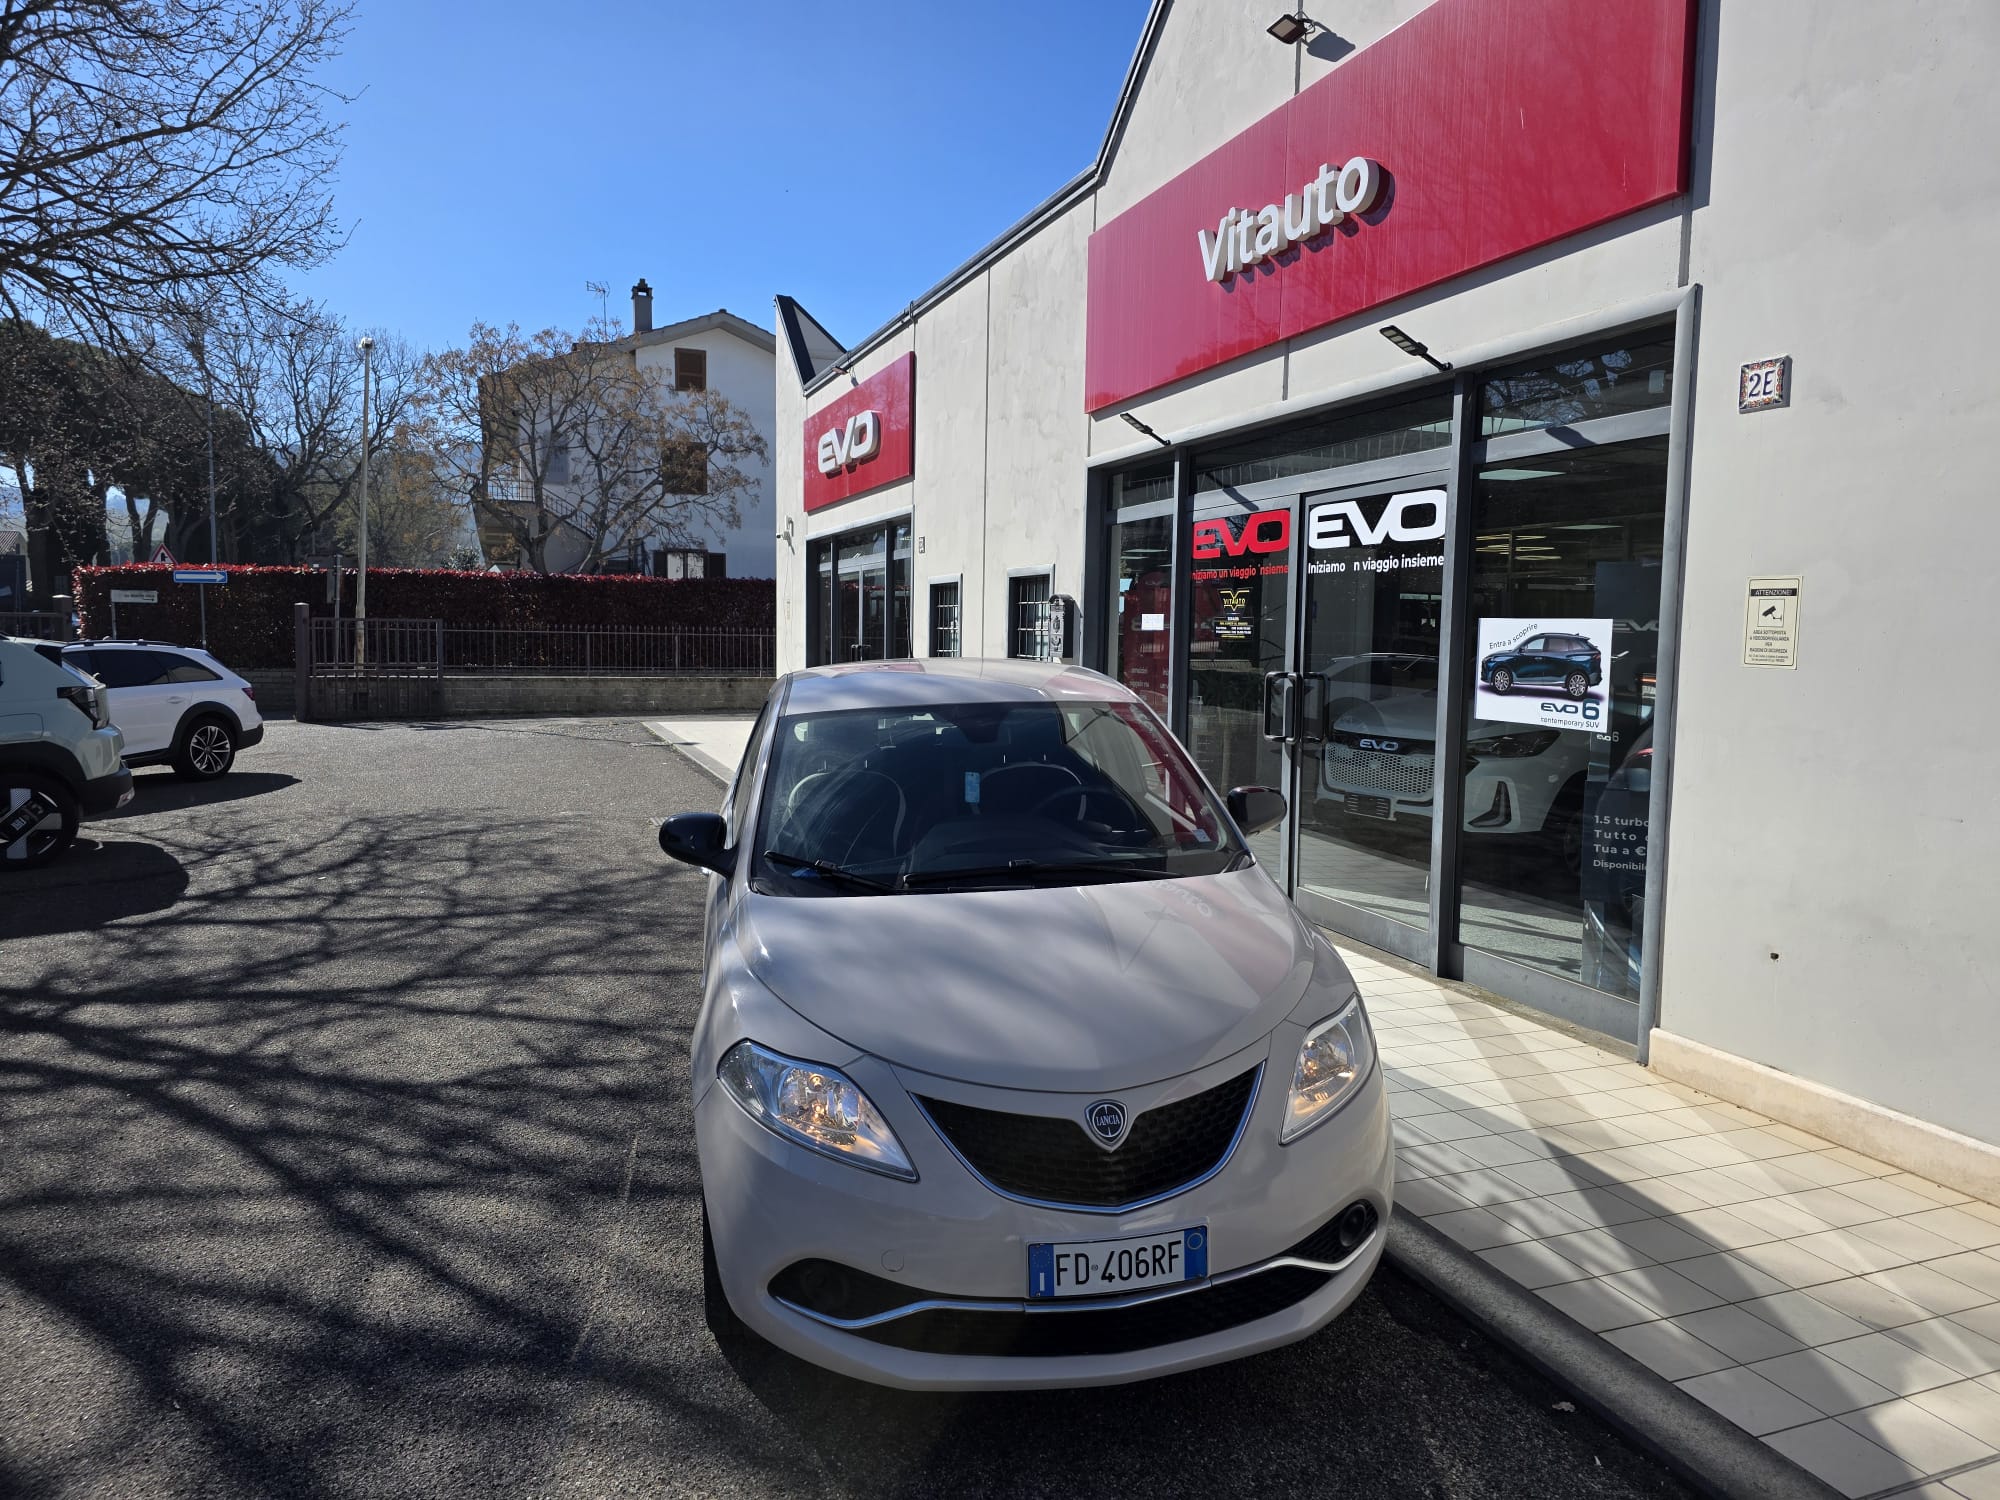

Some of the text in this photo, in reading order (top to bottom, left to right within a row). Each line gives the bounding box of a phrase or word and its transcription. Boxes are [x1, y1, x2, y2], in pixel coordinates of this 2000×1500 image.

[1198, 157, 1374, 281] Vitauto
[818, 410, 877, 473] EVO
[1308, 489, 1447, 549] EVO
[1193, 510, 1290, 559] EVO
[1308, 560, 1346, 574] Iniziamo
[1362, 557, 1399, 573] viaggio
[1401, 553, 1445, 568] insieme
[1230, 566, 1256, 579] viaggio
[1258, 564, 1289, 575] nsieme
[1489, 641, 1506, 650] Entra
[1512, 623, 1538, 641] scoprire
[1541, 698, 1600, 720] EVO 6
[1541, 717, 1600, 728] contemporary SUV
[1612, 731, 1620, 742] 6
[1359, 739, 1399, 751] EVO
[1594, 815, 1611, 824] 1.5
[1594, 829, 1637, 841] Tutto
[1593, 844, 1618, 854] Tua
[1622, 847, 1630, 855] a
[1593, 859, 1647, 870] Disponibil
[1096, 1114, 1121, 1126] LANCIA
[1056, 1253, 1090, 1286] FD
[1101, 1240, 1182, 1283] 406RF
